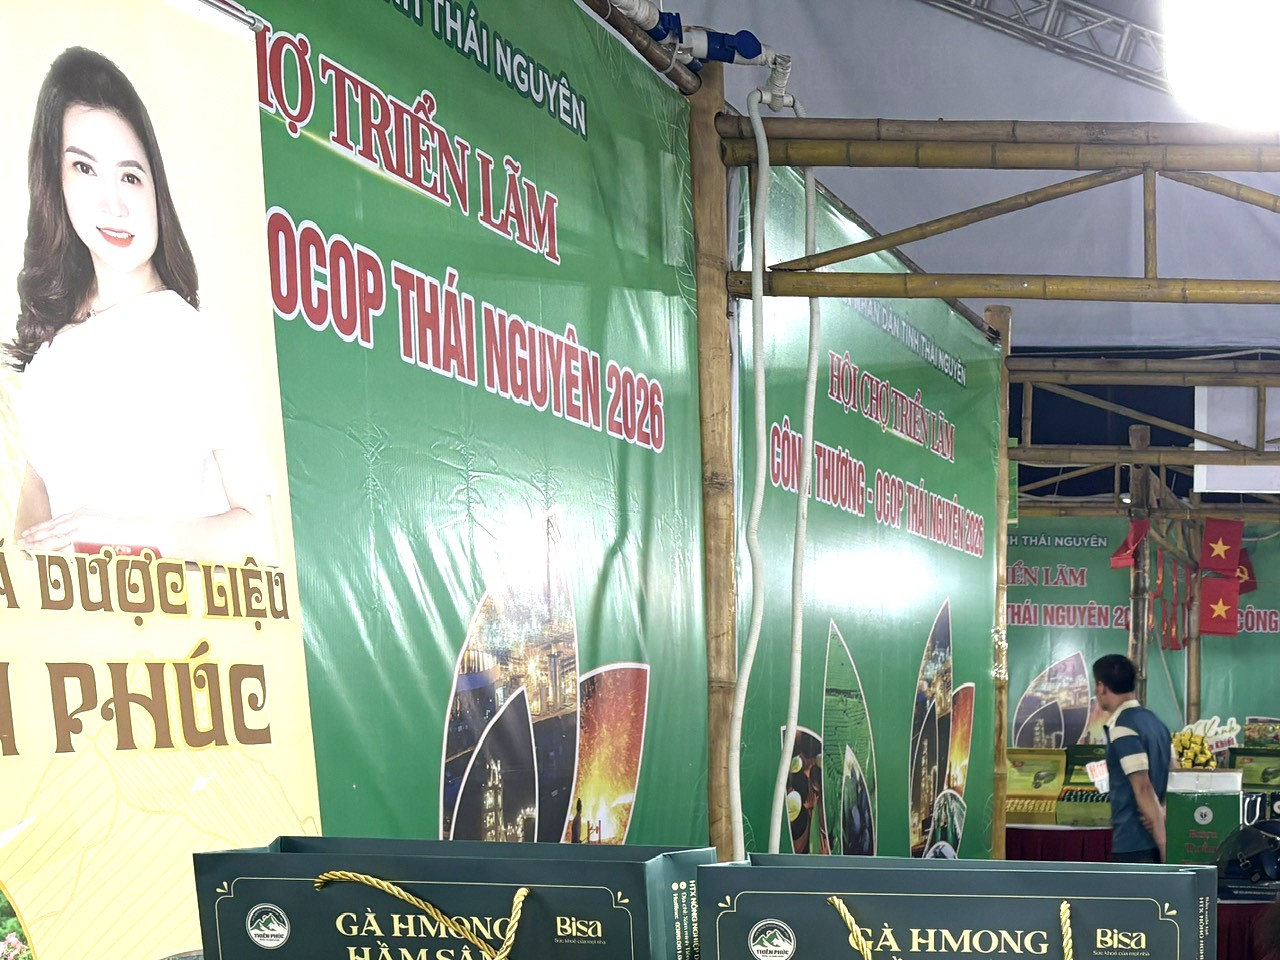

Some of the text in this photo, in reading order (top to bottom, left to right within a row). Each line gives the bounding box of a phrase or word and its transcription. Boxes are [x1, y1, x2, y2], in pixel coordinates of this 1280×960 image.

[432, 0, 587, 137] THÁI NGUYÊN
[321, 53, 468, 214] TRIỂN
[478, 149, 561, 264] LÃM
[267, 206, 664, 452] OCOP THÁI NGUYÊN 2026
[881, 306, 900, 338] DÂN
[920, 334, 938, 364] THÁI
[938, 350, 967, 389] NGUYÊN
[828, 350, 955, 463] HỘI CHỢ TRIỂN LÃM
[770, 415, 985, 558] CÔN THƯƠNG OCOP THÁI NGUYÊN 2026
[1022, 532, 1108, 548] THÁI NGUYÊN
[36, 548, 290, 631] DƯỢC LIỆU
[1043, 564, 1088, 588] LÃM
[1043, 601, 1110, 628] NGUYÊN
[1234, 605, 1280, 633] CÔNG
[45, 640, 272, 754] PHÚC
[335, 907, 385, 937] GÀ
[556, 915, 603, 938] Bisa
[848, 922, 1050, 955] GÀ HMONG
[1095, 927, 1147, 950] Bisa
